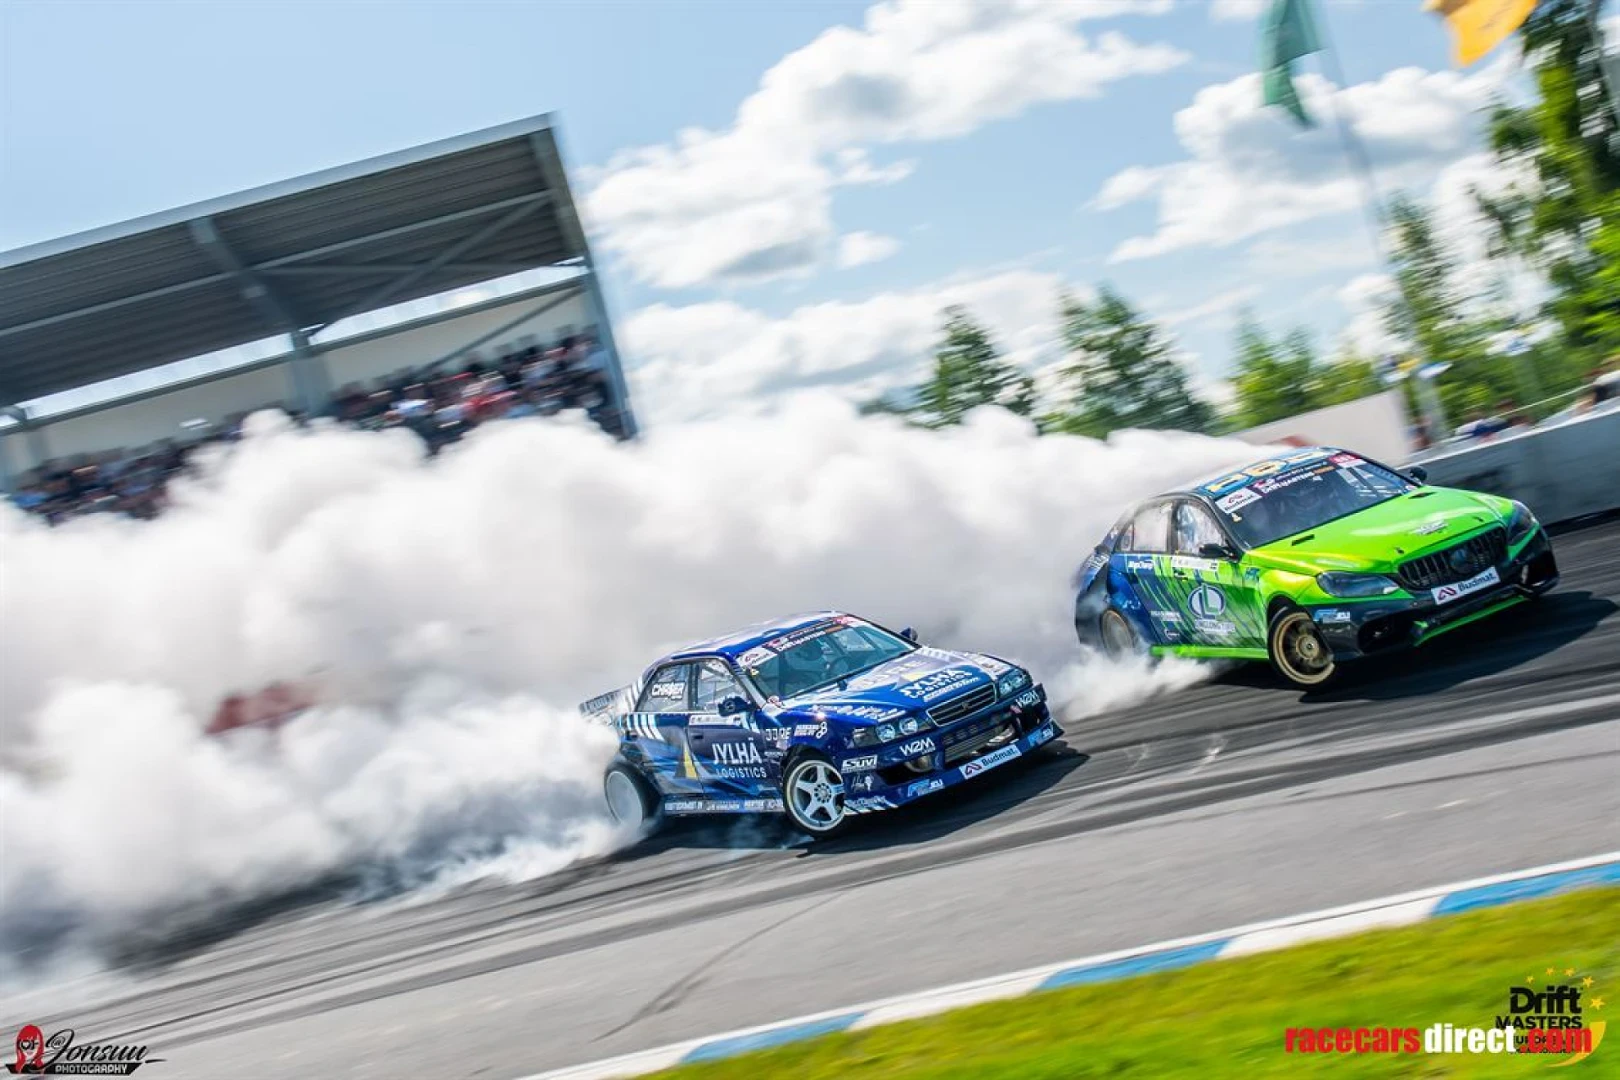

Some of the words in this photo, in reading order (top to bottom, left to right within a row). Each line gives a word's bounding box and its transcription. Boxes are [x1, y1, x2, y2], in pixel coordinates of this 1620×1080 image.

[1458, 573, 1495, 592] Budmat
[712, 737, 762, 765] JYLHÄ
[900, 737, 935, 756] W2M
[981, 748, 1015, 767] Budmat
[715, 766, 767, 778] LOGISTICS
